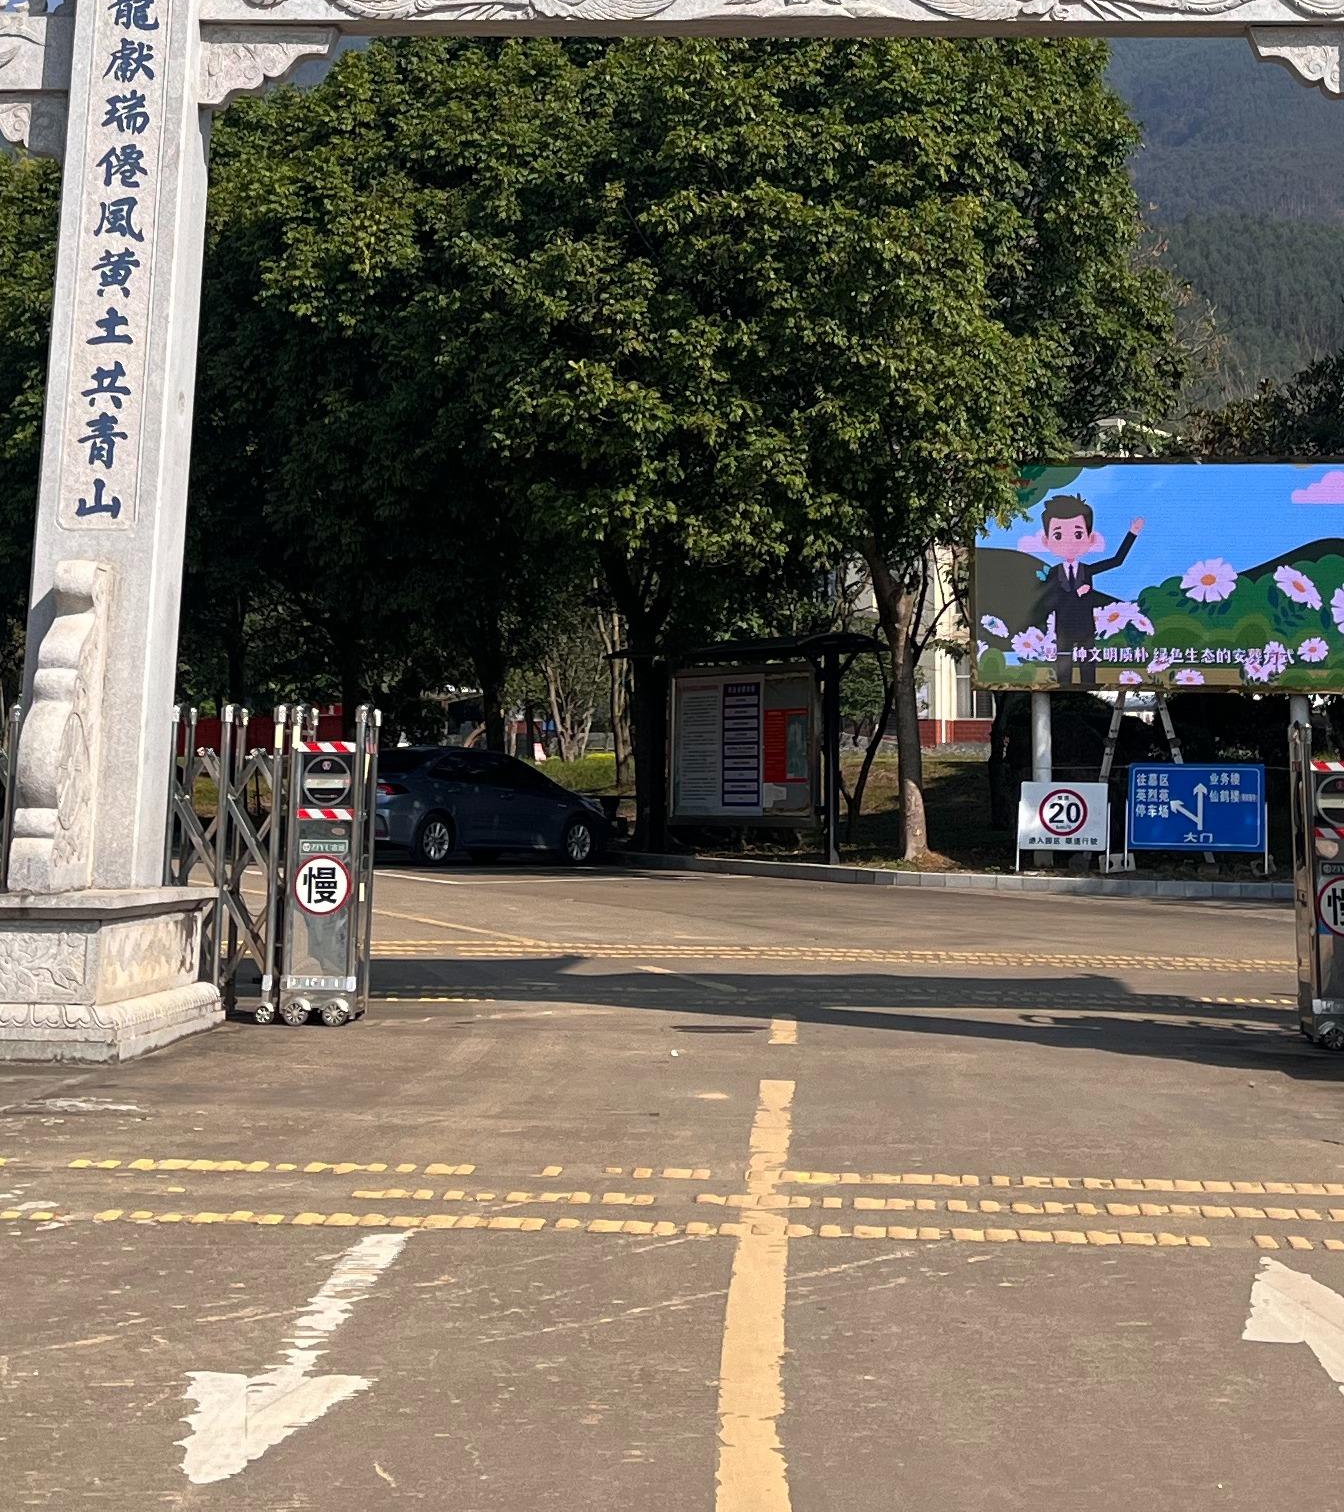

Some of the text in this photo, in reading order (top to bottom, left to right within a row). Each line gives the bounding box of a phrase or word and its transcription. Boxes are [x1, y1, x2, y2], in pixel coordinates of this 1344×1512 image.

[1049, 802, 1081, 824] 20
[1183, 831, 1213, 843] 大门
[302, 866, 338, 905] 慢
